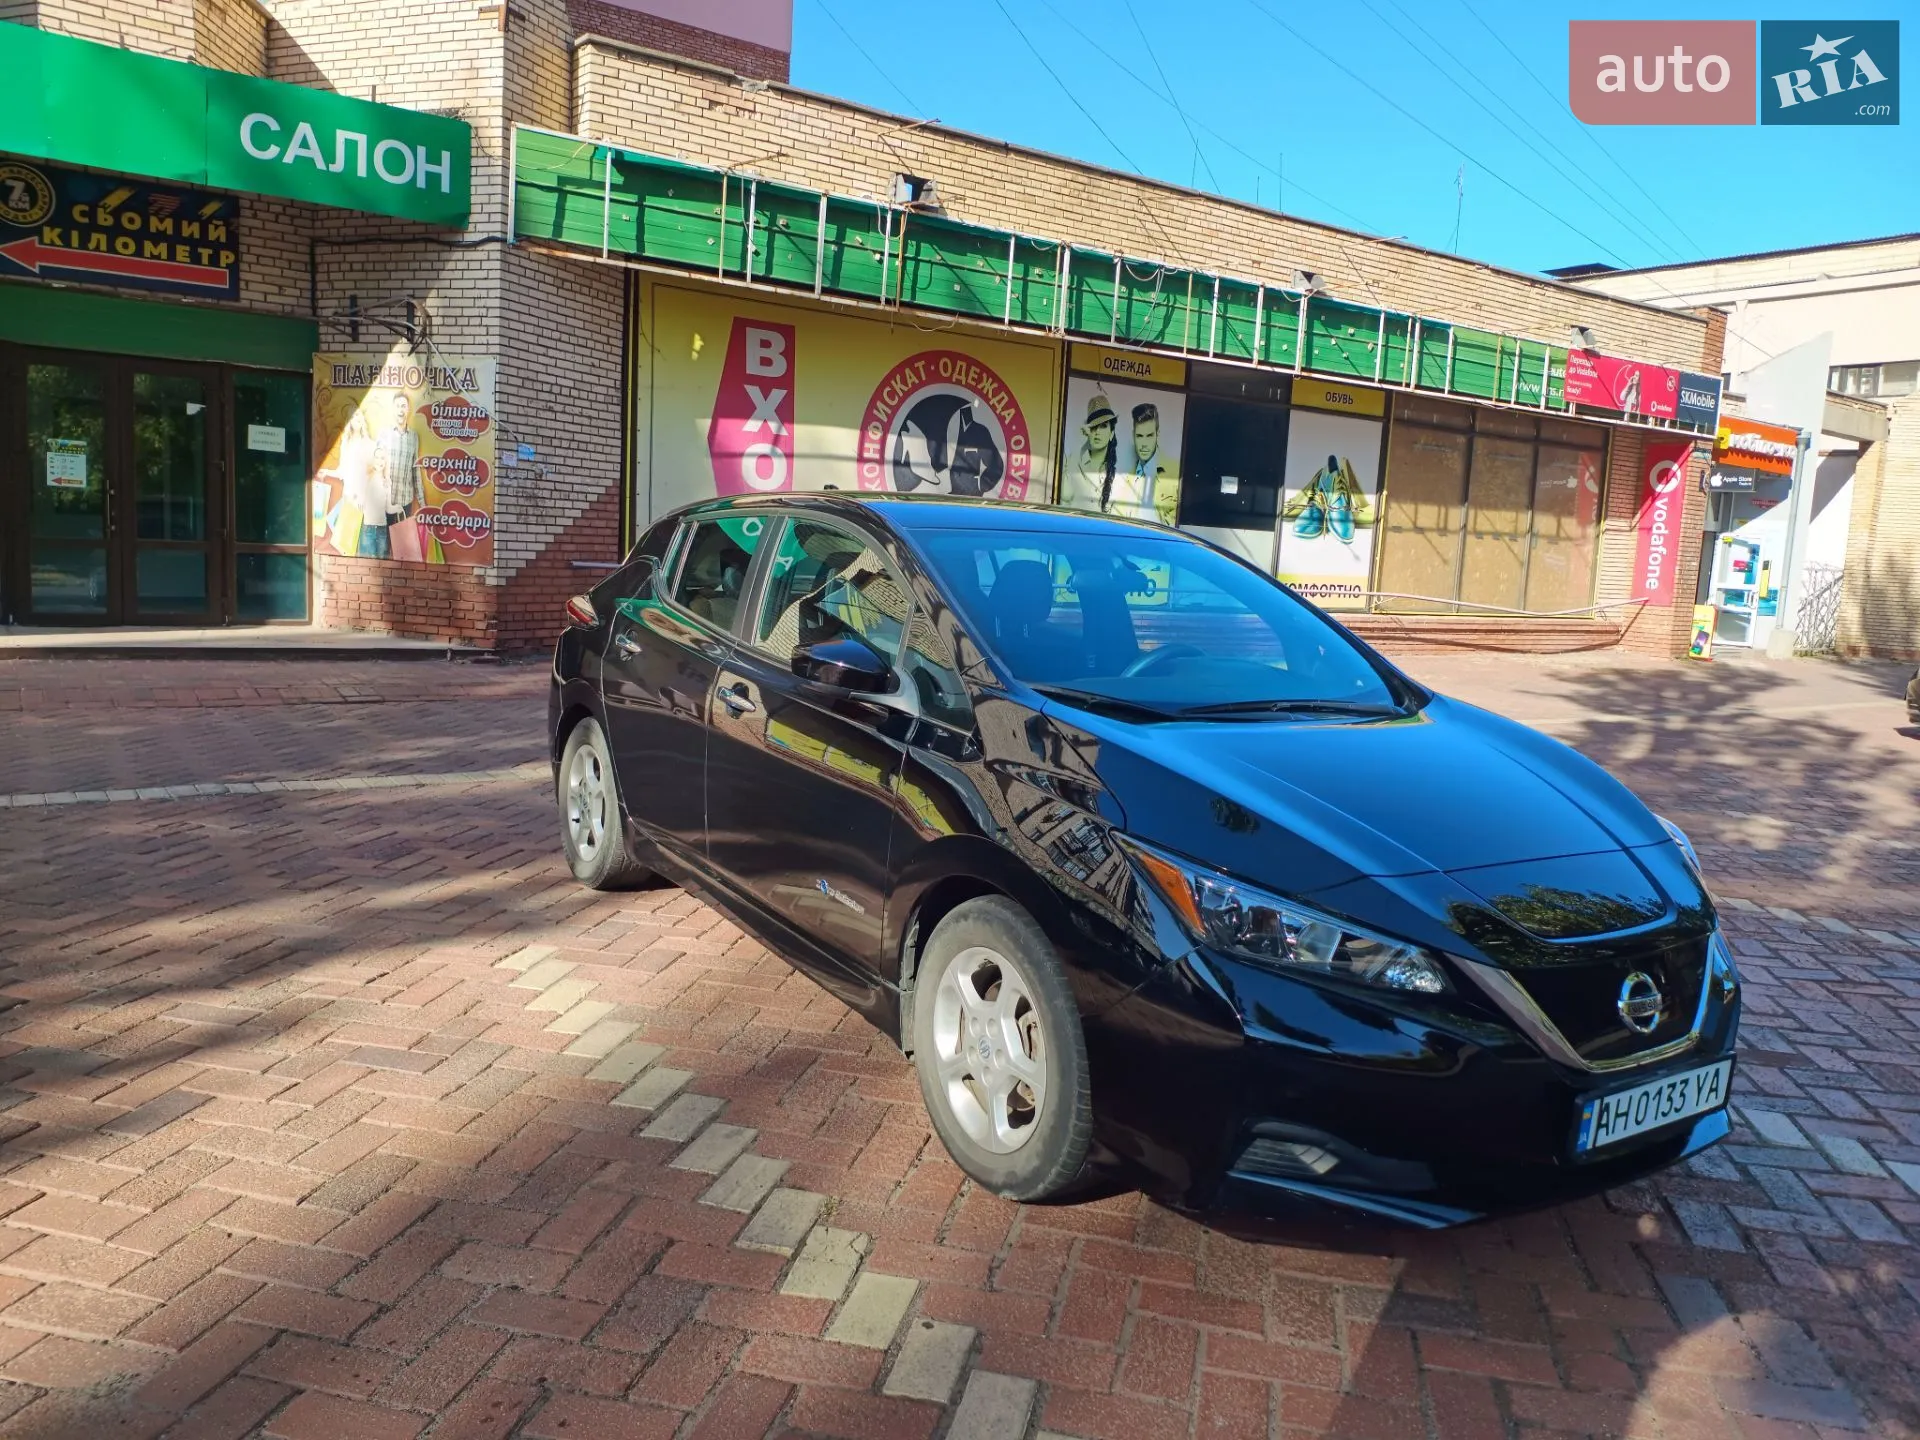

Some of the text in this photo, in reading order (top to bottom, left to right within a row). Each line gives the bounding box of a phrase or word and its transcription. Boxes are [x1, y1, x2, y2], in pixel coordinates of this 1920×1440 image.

[239, 112, 451, 194] САЛОН
[71, 203, 227, 243] СЬОМИЙ
[42, 225, 236, 268] КІЛОМЕТР
[331, 364, 479, 393] ПАННОЧКА
[1103, 357, 1152, 376] ОДЕЖДА
[938, 357, 1016, 425] ОДЕЖДА
[1325, 391, 1354, 405] ОБУВЬ
[431, 401, 487, 418] білизна
[741, 326, 789, 491] ВХО
[422, 454, 476, 475] верхній
[447, 468, 480, 487] одяг
[1005, 434, 1026, 499] ОБУВ
[416, 512, 491, 531] аксесуари
[1645, 497, 1669, 590] vodafone
[1284, 582, 1362, 599] ОМФОРТНО
